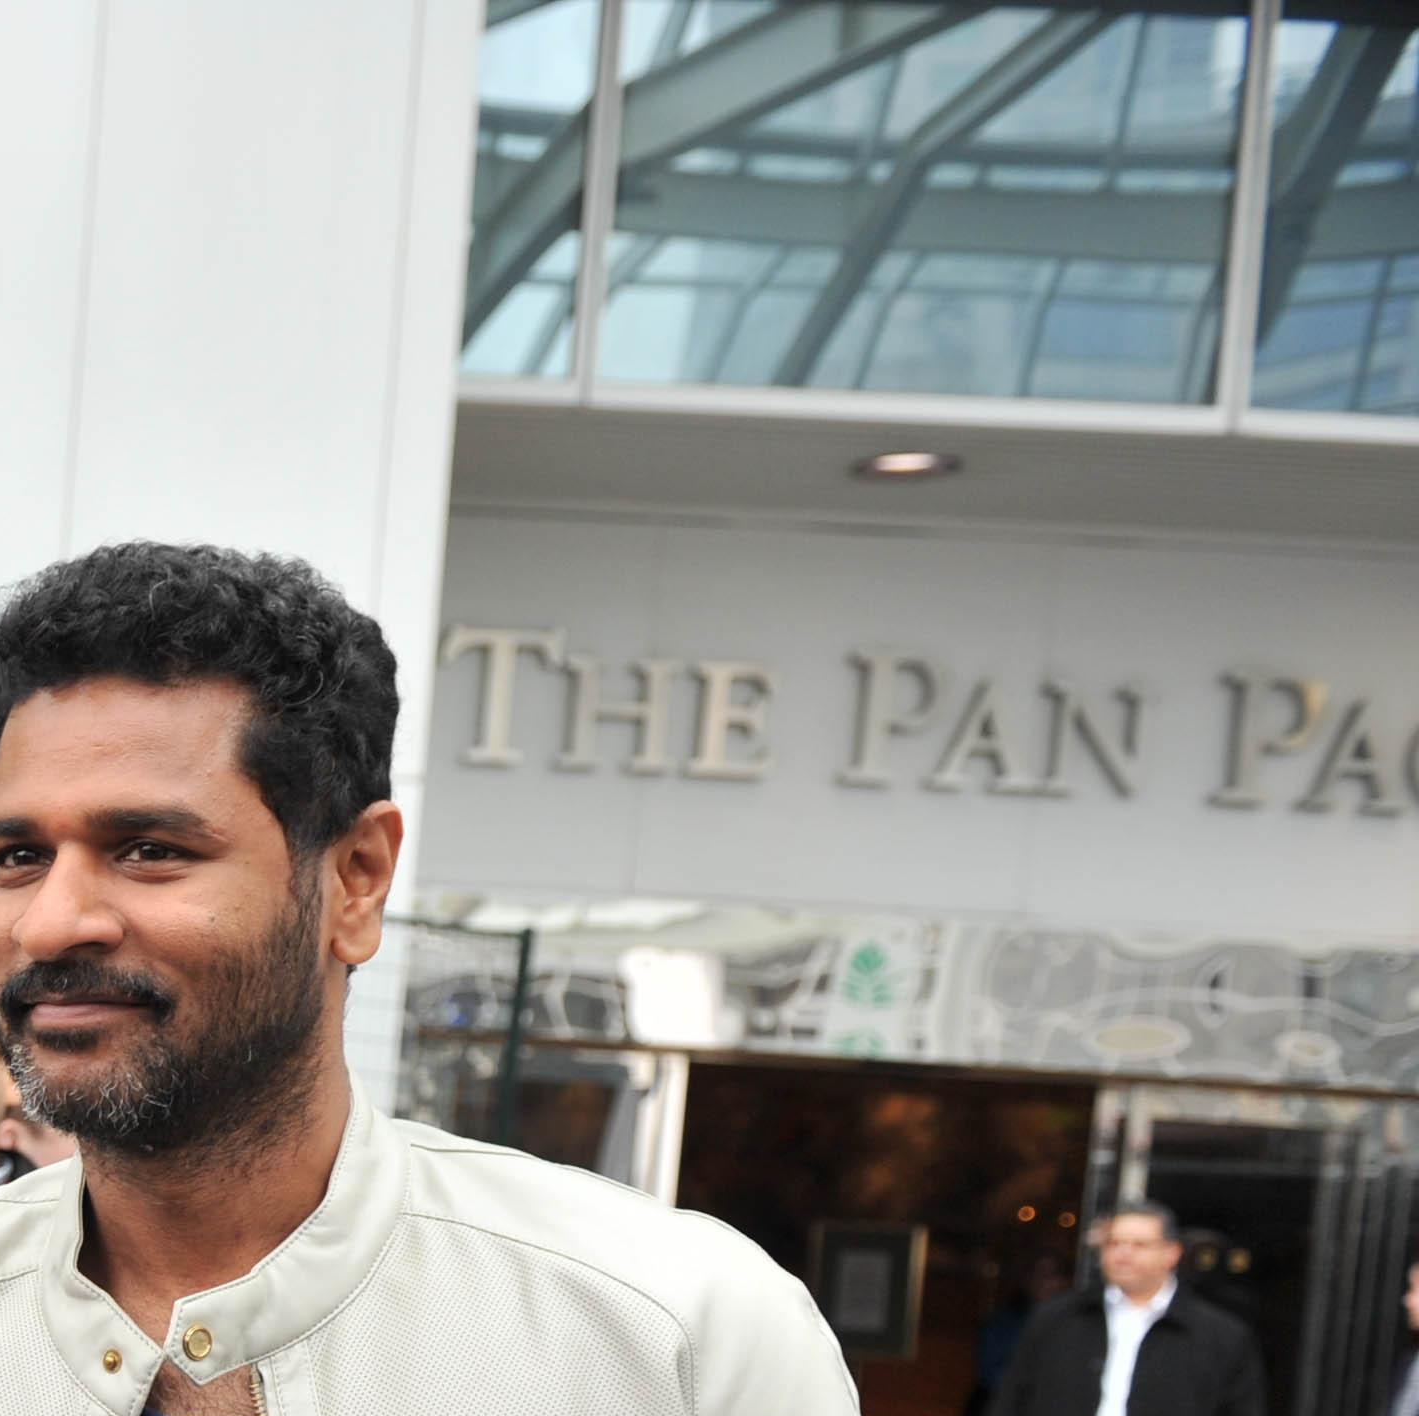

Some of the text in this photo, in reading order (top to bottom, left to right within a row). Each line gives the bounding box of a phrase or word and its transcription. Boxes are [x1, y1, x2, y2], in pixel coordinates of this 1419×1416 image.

[437, 624, 1419, 818] THE PAN PA
